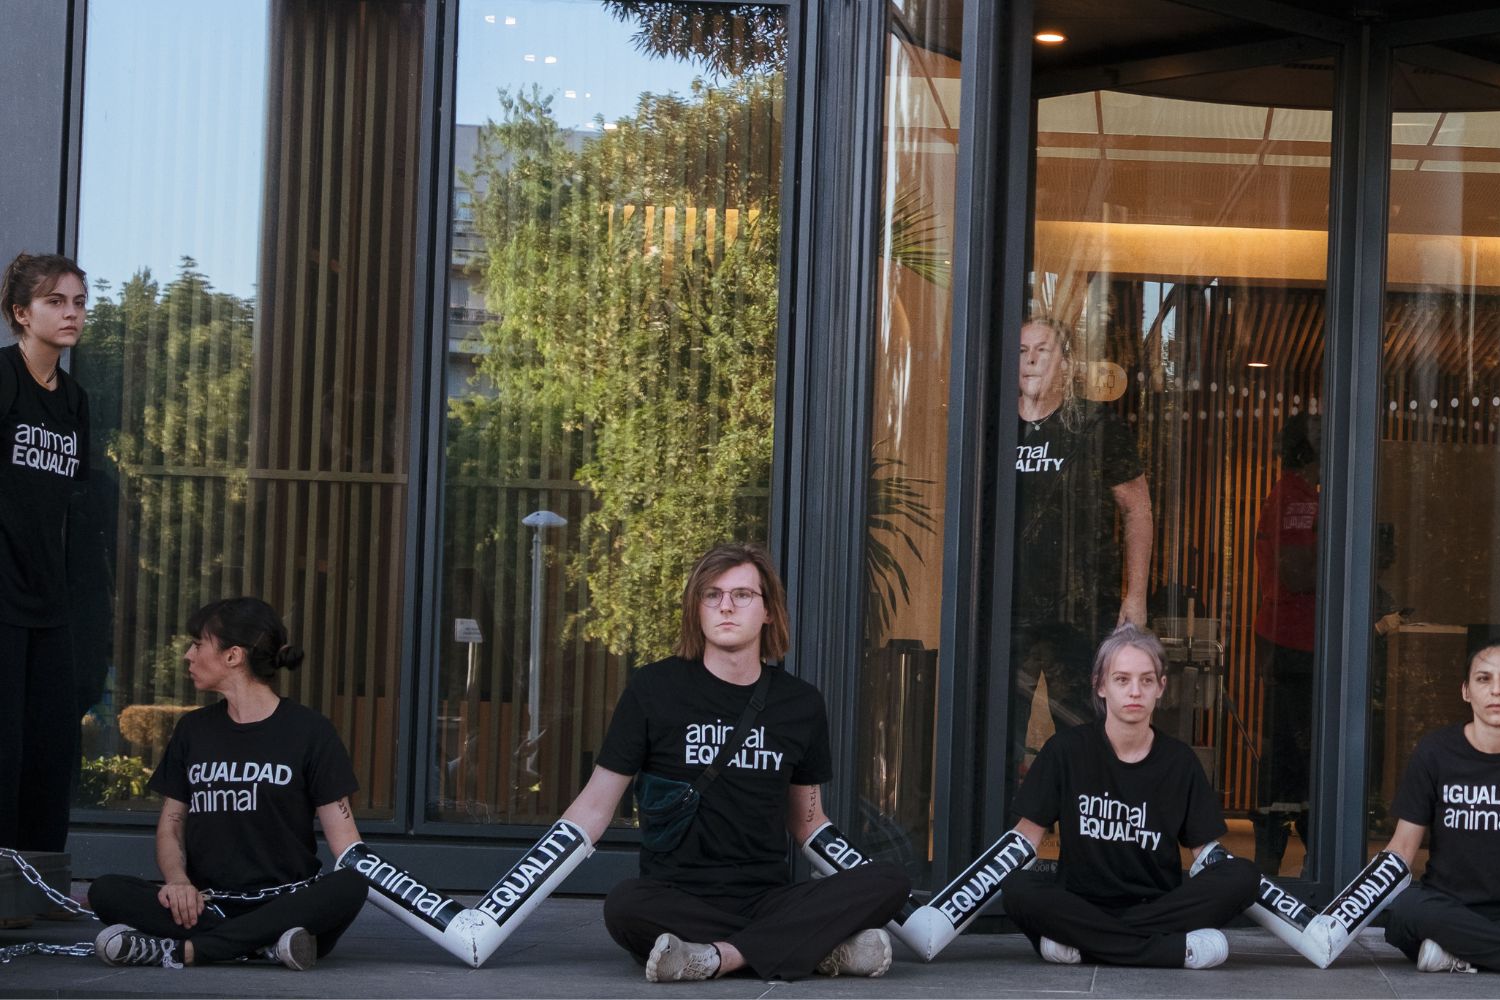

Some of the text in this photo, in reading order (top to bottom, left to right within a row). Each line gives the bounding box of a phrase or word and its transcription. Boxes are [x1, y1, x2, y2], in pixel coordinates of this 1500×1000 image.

[15, 422, 77, 456] animal
[1016, 441, 1049, 459] mal
[1015, 458, 1064, 472] ALITY
[188, 761, 293, 785] GUALDAD
[685, 744, 783, 771] EQALITY
[1078, 791, 1147, 828] animal
[1079, 815, 1161, 851] EQUALITY
[355, 853, 454, 919] animal
[479, 822, 578, 921] EQUALITY
[940, 835, 1030, 925] EQUALITY
[1259, 876, 1306, 919] mal
[1332, 853, 1404, 928] EQUALITY
